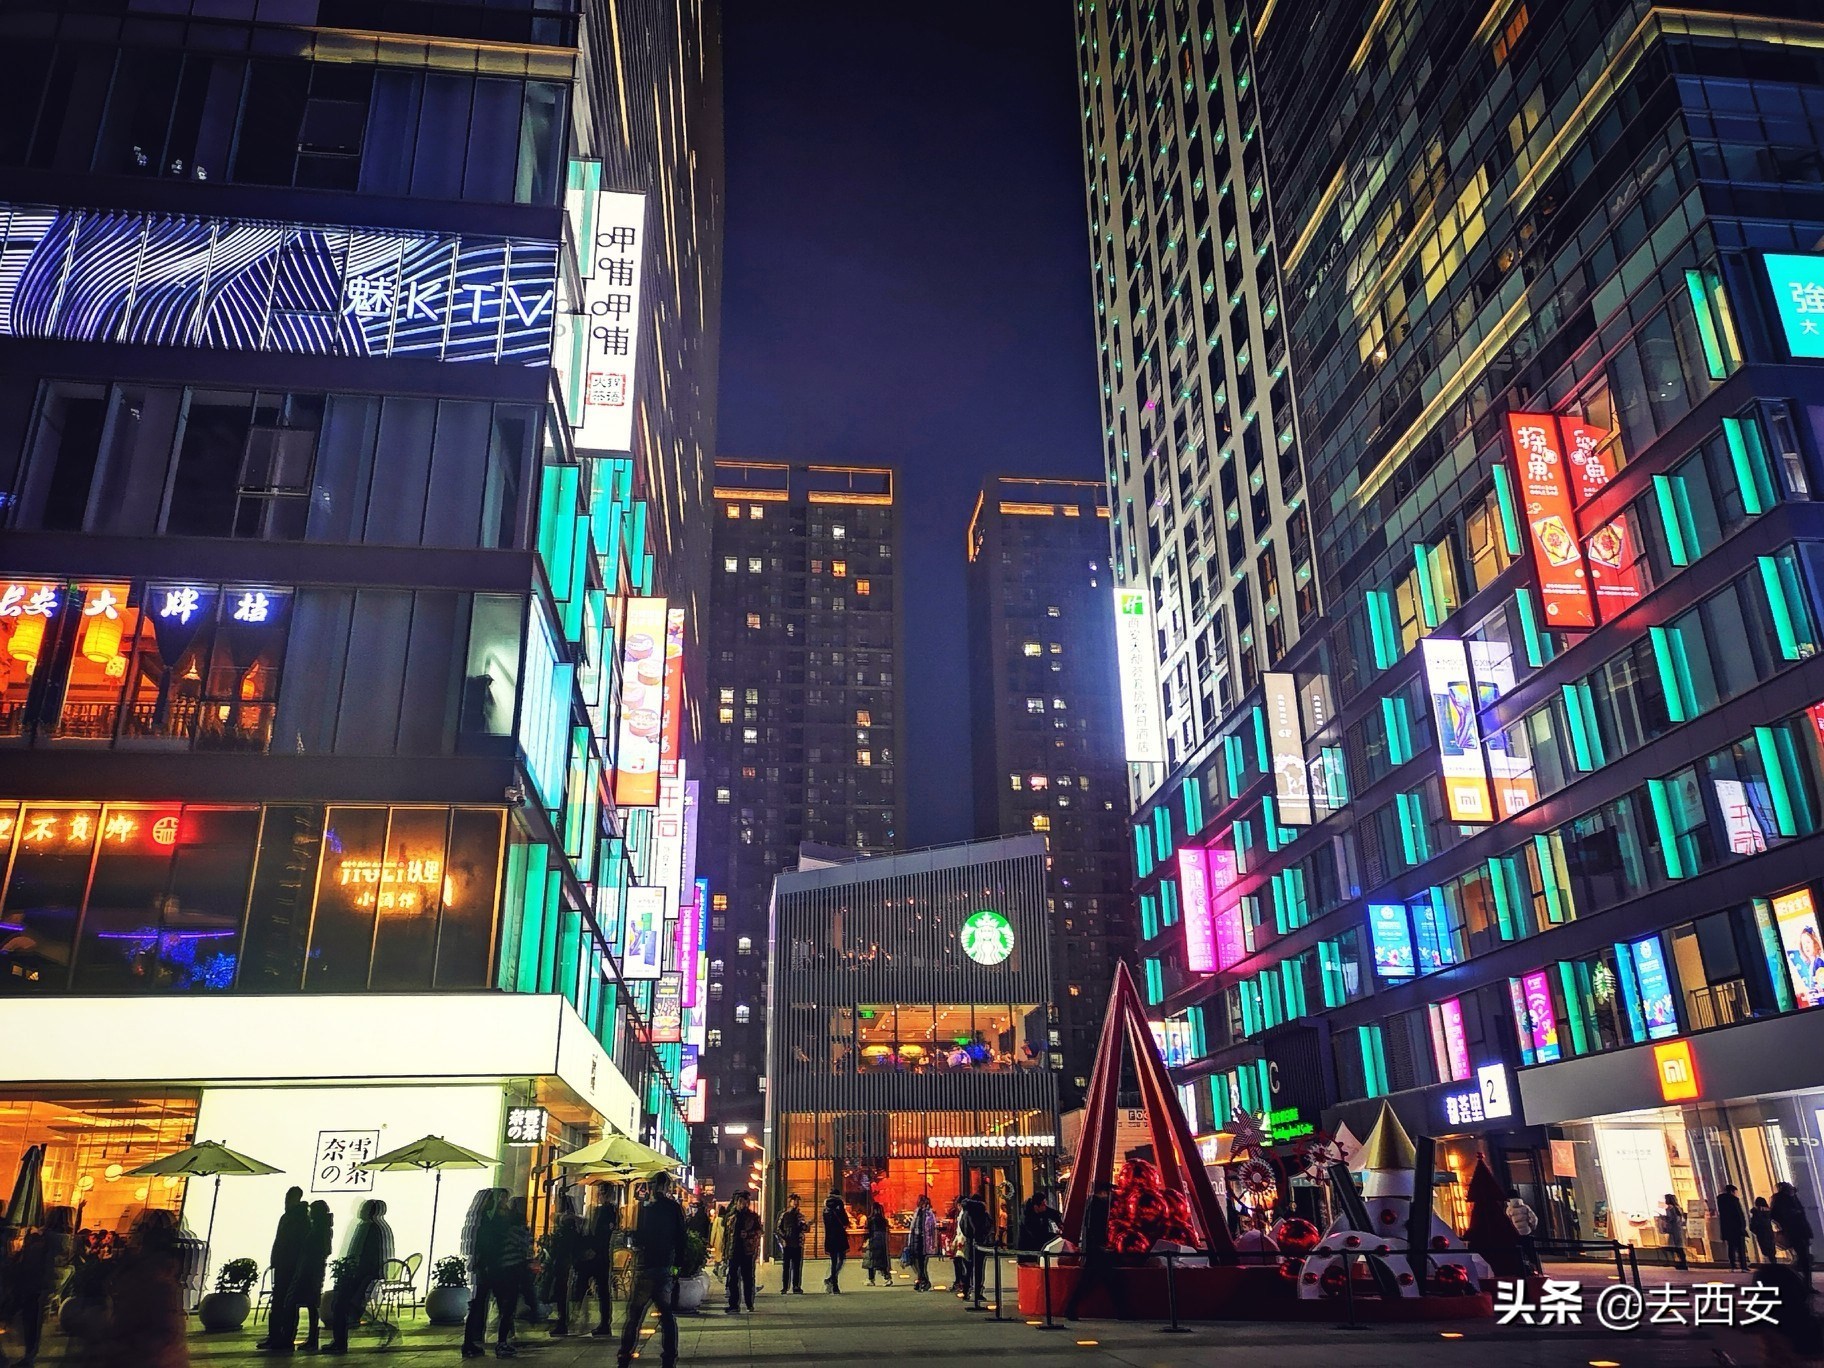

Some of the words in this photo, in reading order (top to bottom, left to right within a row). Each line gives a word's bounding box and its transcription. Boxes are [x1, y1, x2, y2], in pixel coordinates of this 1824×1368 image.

[591, 226, 635, 356] 呷哺呷哺
[1268, 1060, 1281, 1095] C
[1486, 1079, 1497, 1104] 2
[323, 1137, 372, 1161] 奈雪
[928, 1136, 1006, 1149] STARBUCKS
[1006, 1135, 1056, 1148] COFFEE
[320, 1160, 369, 1185] の茶
